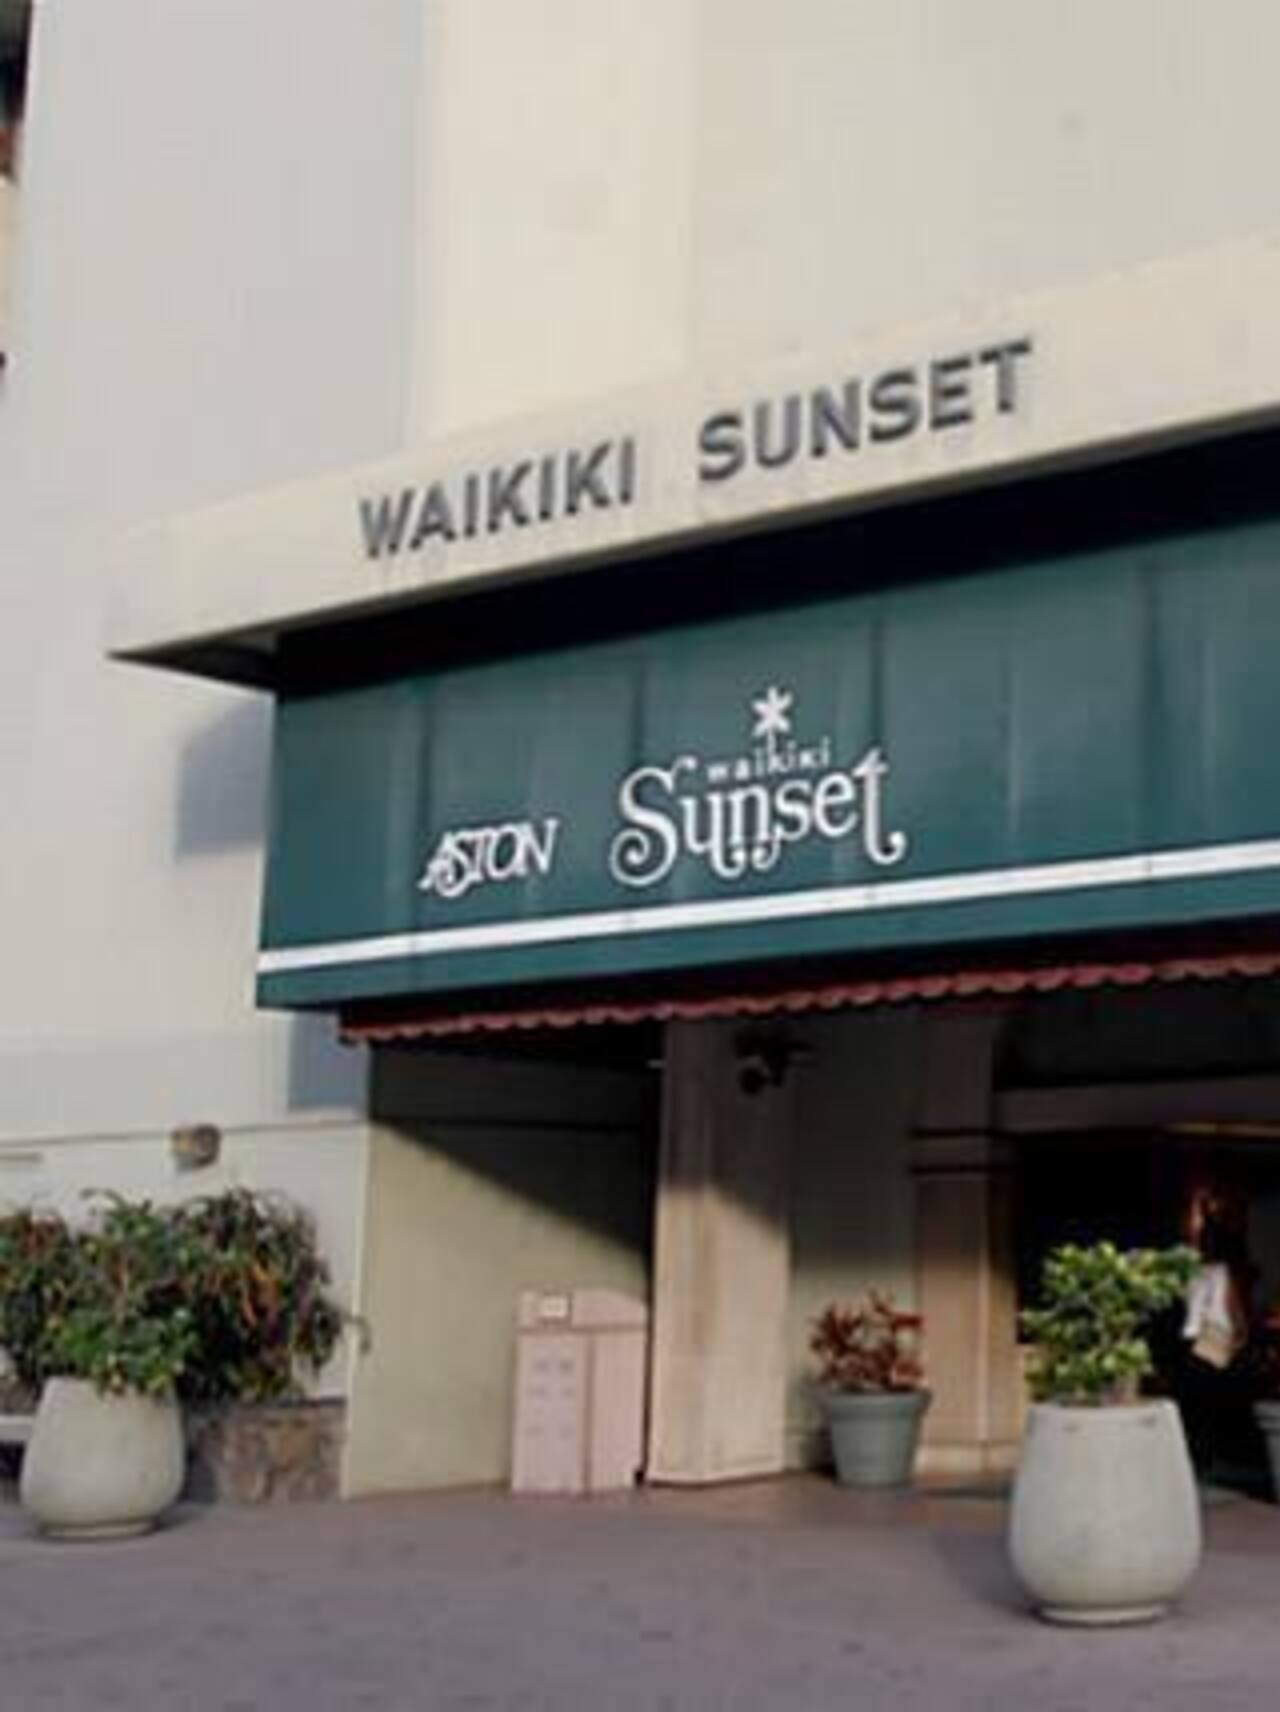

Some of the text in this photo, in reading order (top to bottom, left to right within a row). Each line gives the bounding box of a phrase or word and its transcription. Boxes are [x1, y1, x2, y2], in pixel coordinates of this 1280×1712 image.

[360, 338, 1032, 558] WAIKIKI SUNSET
[418, 817, 560, 898] ASTON
[610, 748, 906, 887] Sunset
